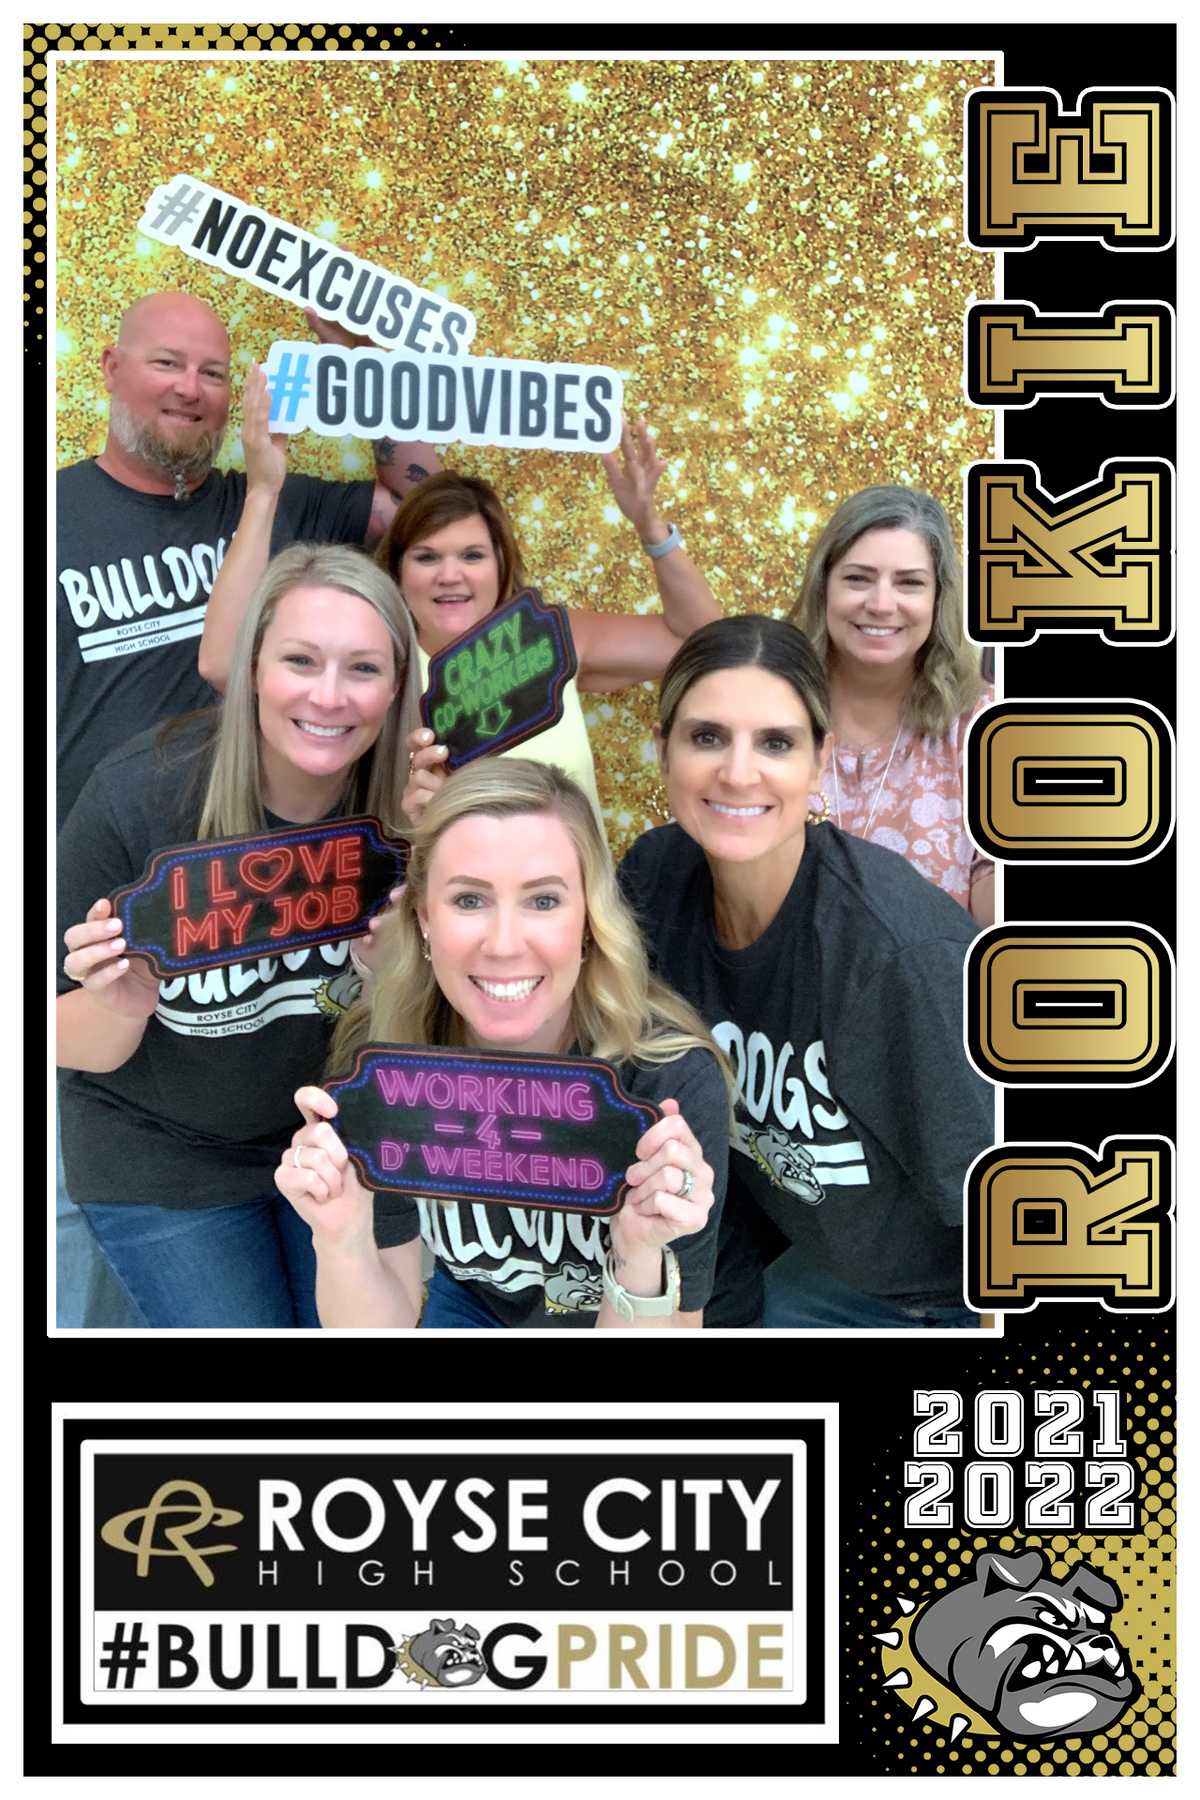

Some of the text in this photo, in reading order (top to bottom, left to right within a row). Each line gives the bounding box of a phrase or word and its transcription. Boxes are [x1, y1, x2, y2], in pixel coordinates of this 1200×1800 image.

[148, 181, 468, 356] #NOEXCUSES
[268, 352, 612, 443] #GOODVIBES
[59, 533, 235, 628] BULLDO
[115, 633, 171, 653] HIGH SCHOOL
[116, 620, 161, 637] ROYSE CITY
[444, 612, 521, 696] CRAZY
[434, 638, 553, 734] CO-WORKERS
[177, 885, 359, 957] MY JOB
[189, 1016, 265, 1036] HIGH SCHOOL
[196, 1001, 259, 1022] ROYSE CITY
[421, 1144, 604, 1190] WEEKEND
